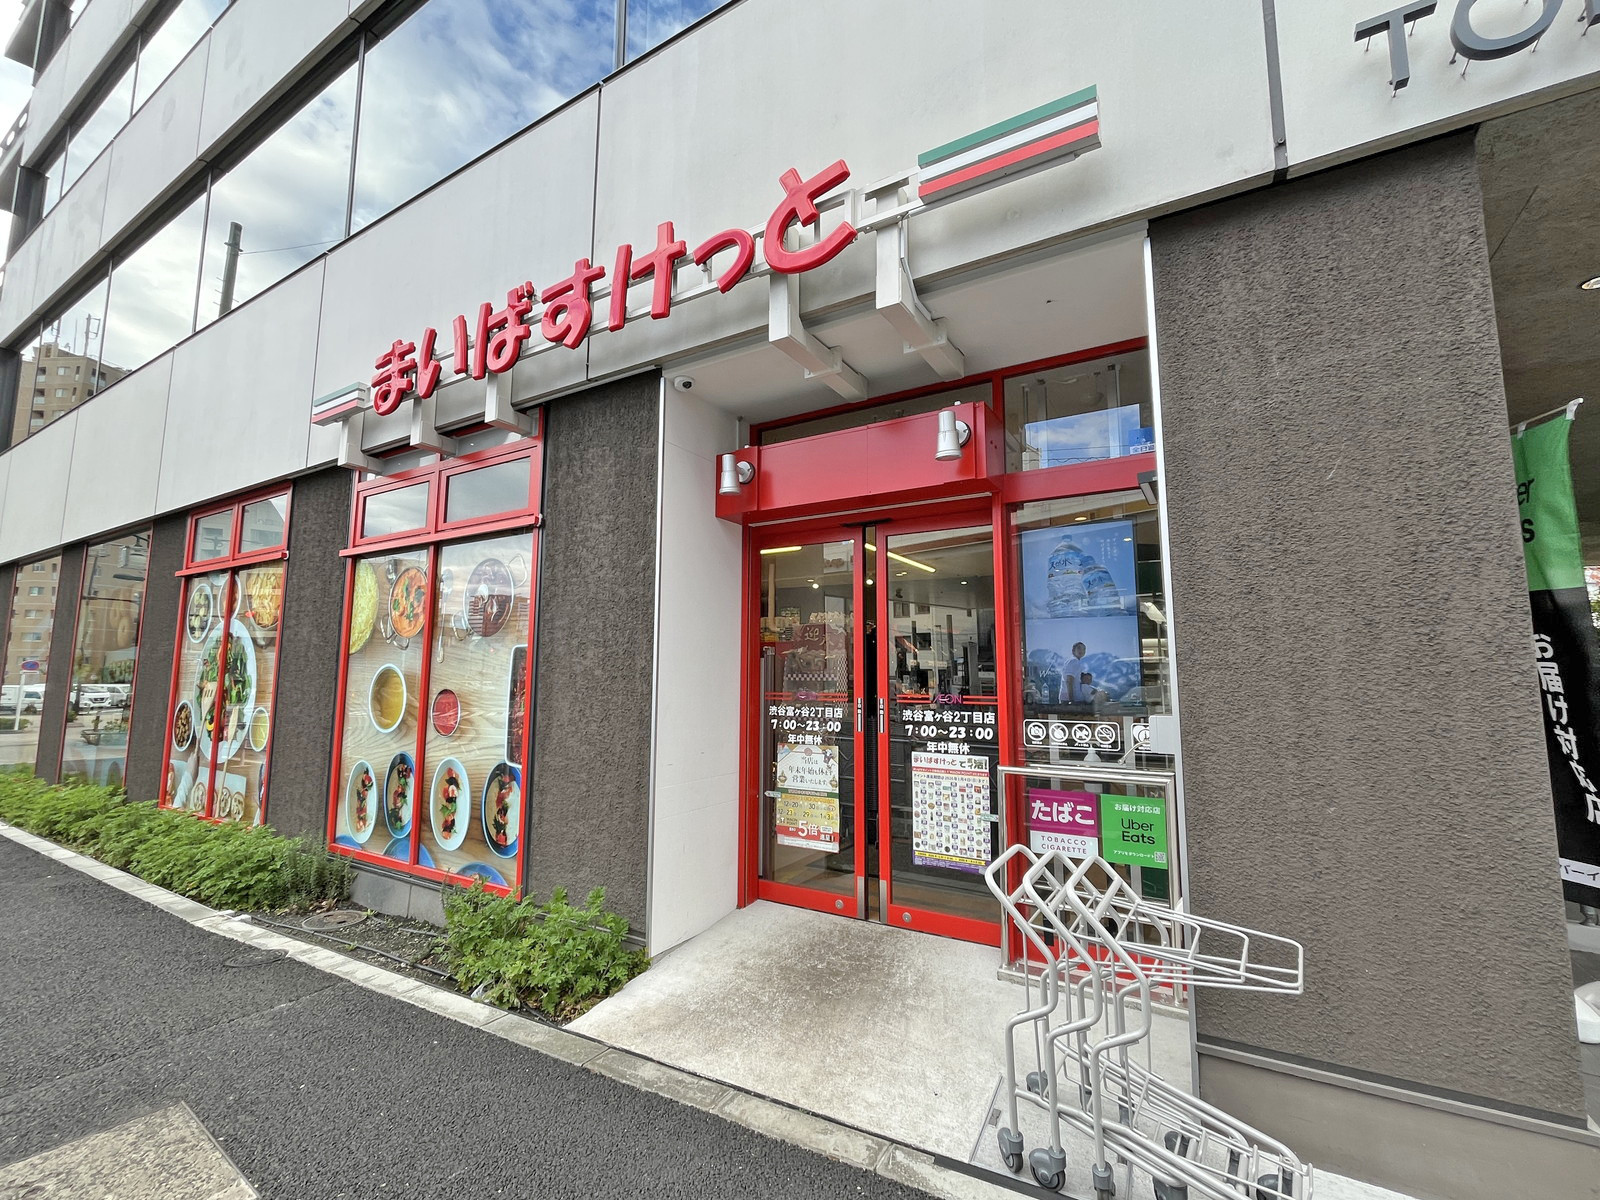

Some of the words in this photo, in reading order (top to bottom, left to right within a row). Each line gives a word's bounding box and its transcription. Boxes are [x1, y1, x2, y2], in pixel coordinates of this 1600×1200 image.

[1353, 0, 1600, 91] TO
[371, 158, 858, 417] まいばすけっと
[787, 733, 823, 746] 年中無休
[926, 740, 971, 755] 年中無休
[913, 755, 957, 766] まいばすけっと
[1031, 799, 1095, 825] たばこ
[1114, 803, 1161, 815] お届け対応店
[1121, 818, 1155, 832] Uber
[1041, 835, 1087, 846] TOBACCO
[1121, 831, 1156, 845] Eats
[1041, 843, 1087, 855] CIGARETTE
